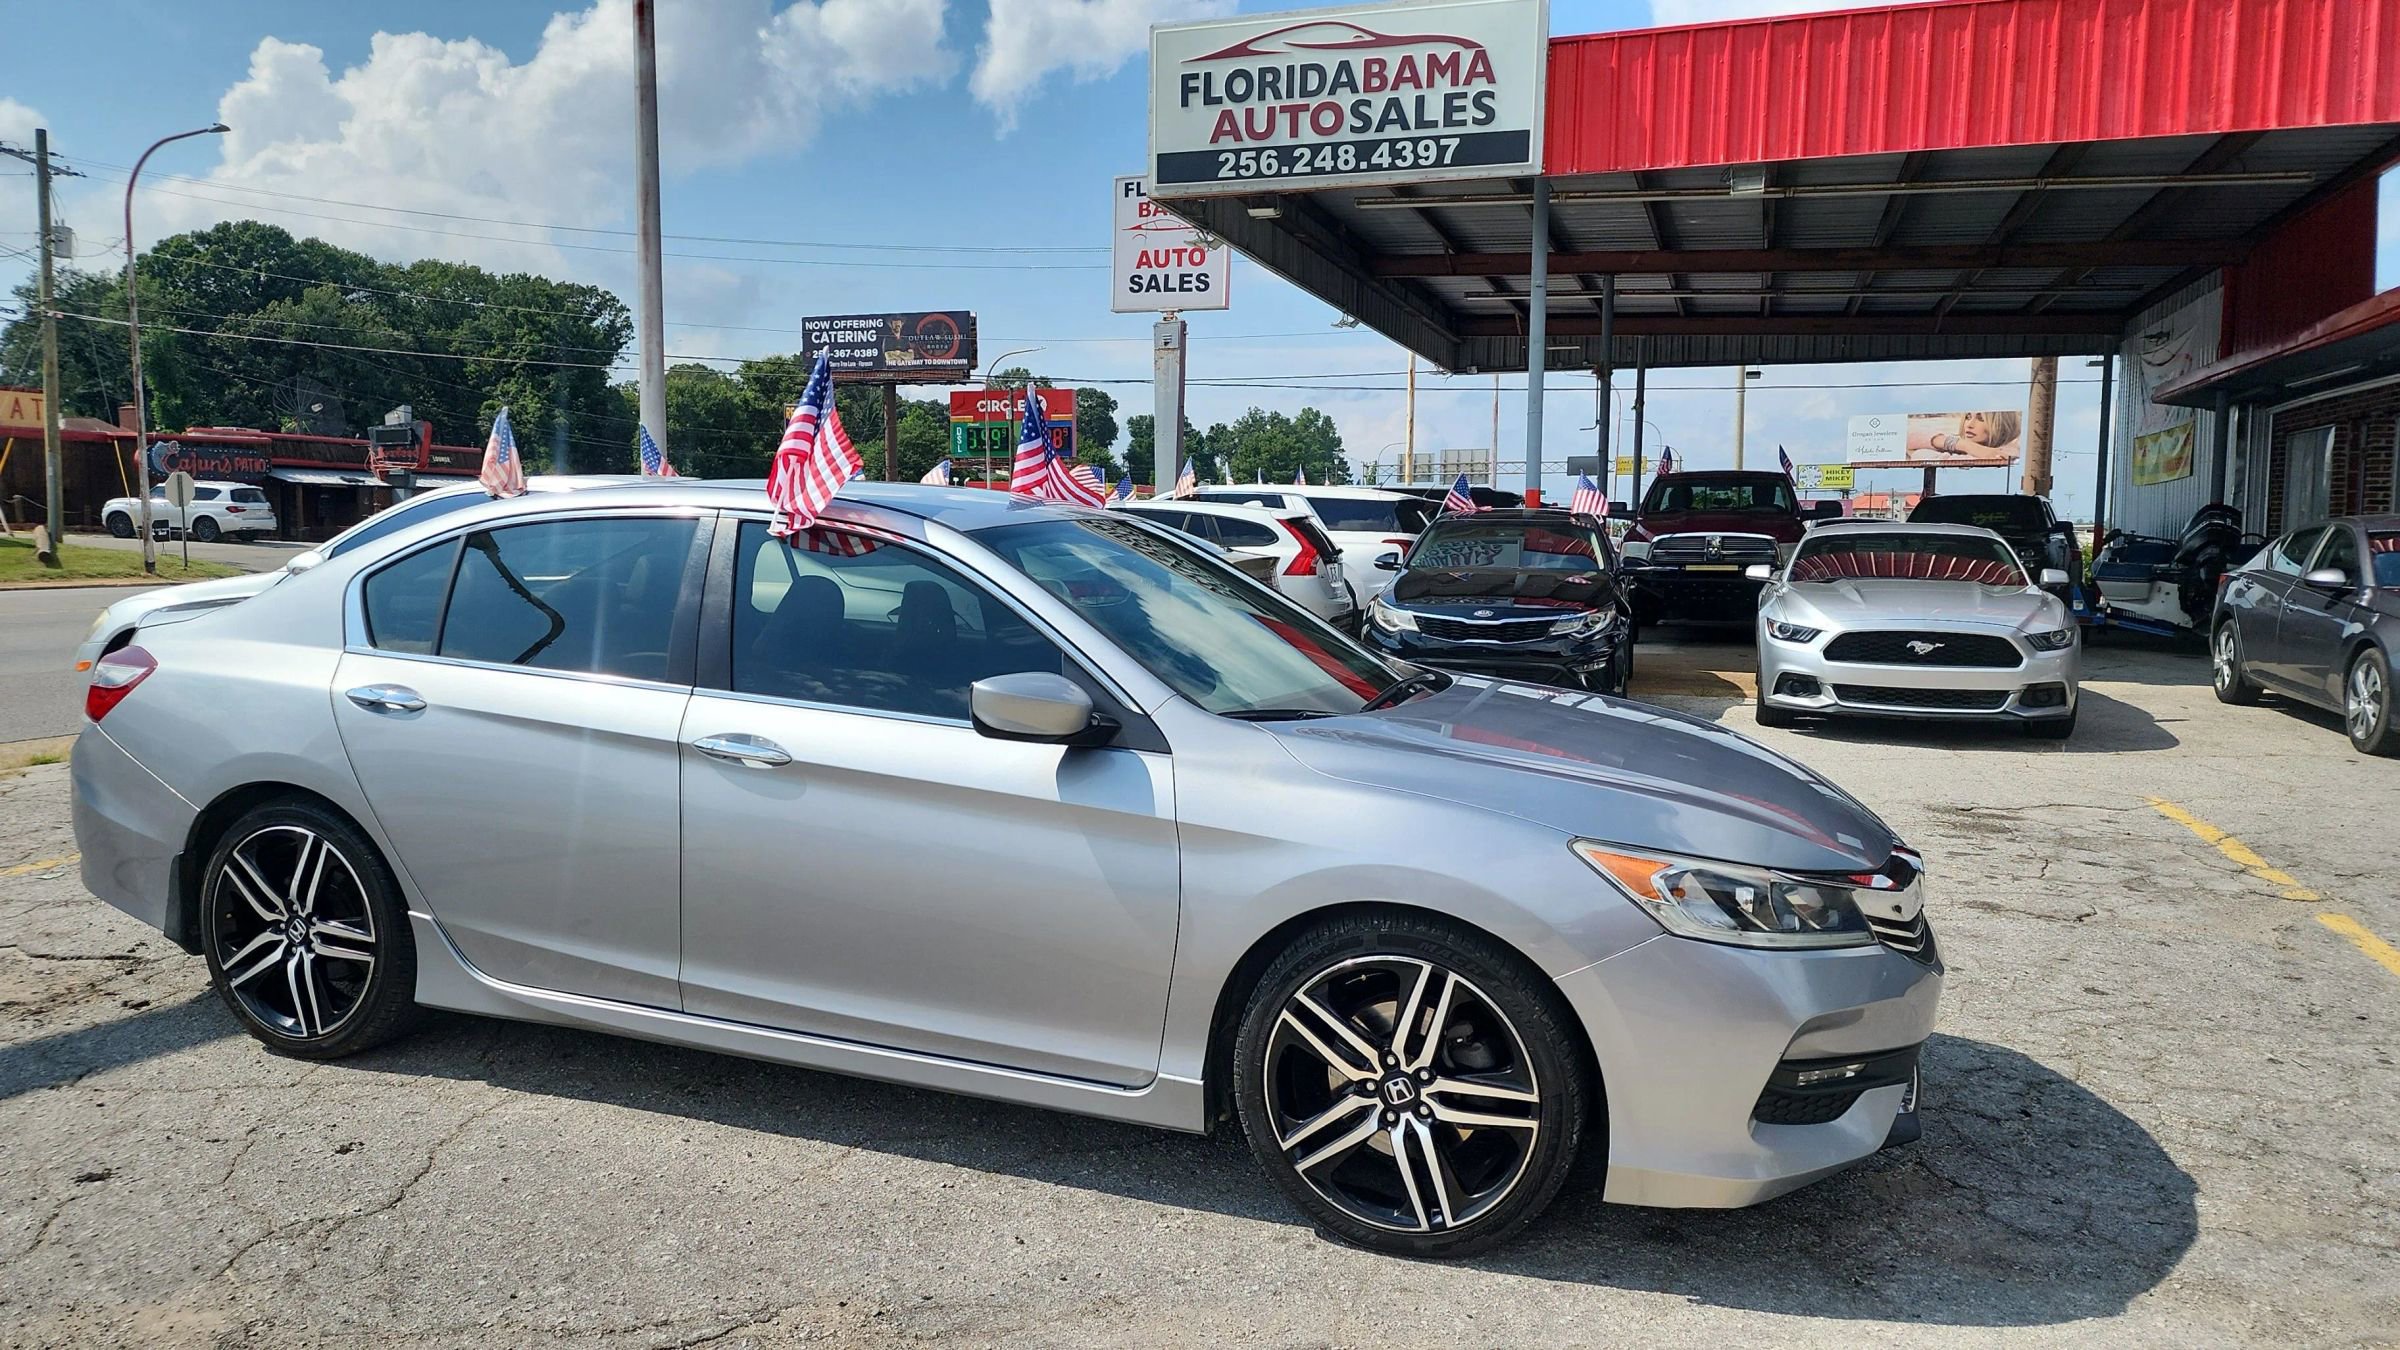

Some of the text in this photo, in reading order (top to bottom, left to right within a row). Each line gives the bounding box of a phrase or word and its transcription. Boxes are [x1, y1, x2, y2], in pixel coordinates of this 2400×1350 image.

[1181, 49, 1497, 108] FLORIDABAMA
[1217, 137, 1460, 178] 256.248.4397
[1136, 247, 1206, 269] AUTO
[1129, 272, 1210, 293] SALES
[805, 318, 884, 330] NOW OFFERING
[811, 329, 877, 343] CATERING
[161, 452, 266, 478] Cajun's PATIO
